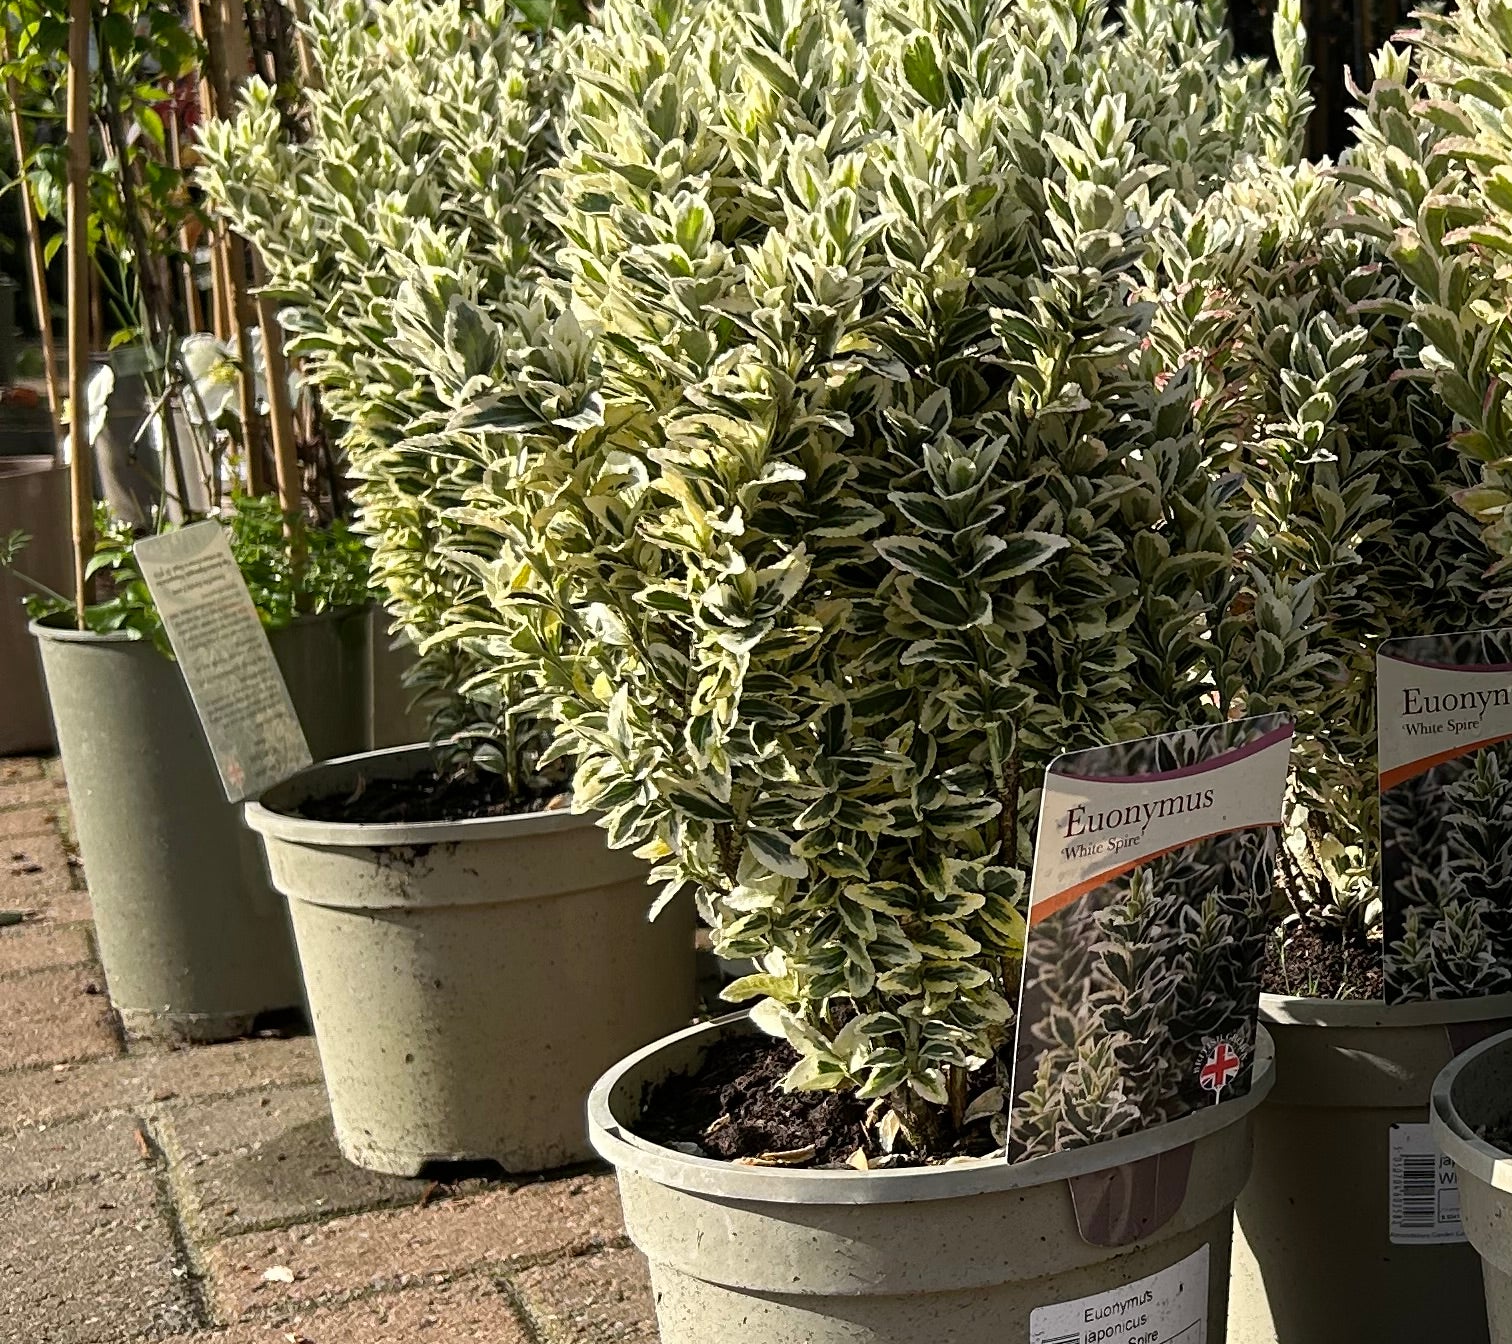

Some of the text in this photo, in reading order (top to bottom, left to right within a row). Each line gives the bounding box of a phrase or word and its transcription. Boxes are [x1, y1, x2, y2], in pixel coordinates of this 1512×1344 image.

[1064, 789, 1214, 838] Euonymus
[1061, 830, 1145, 860] 'White Spire'
[1084, 1289, 1153, 1323] Euonymus
